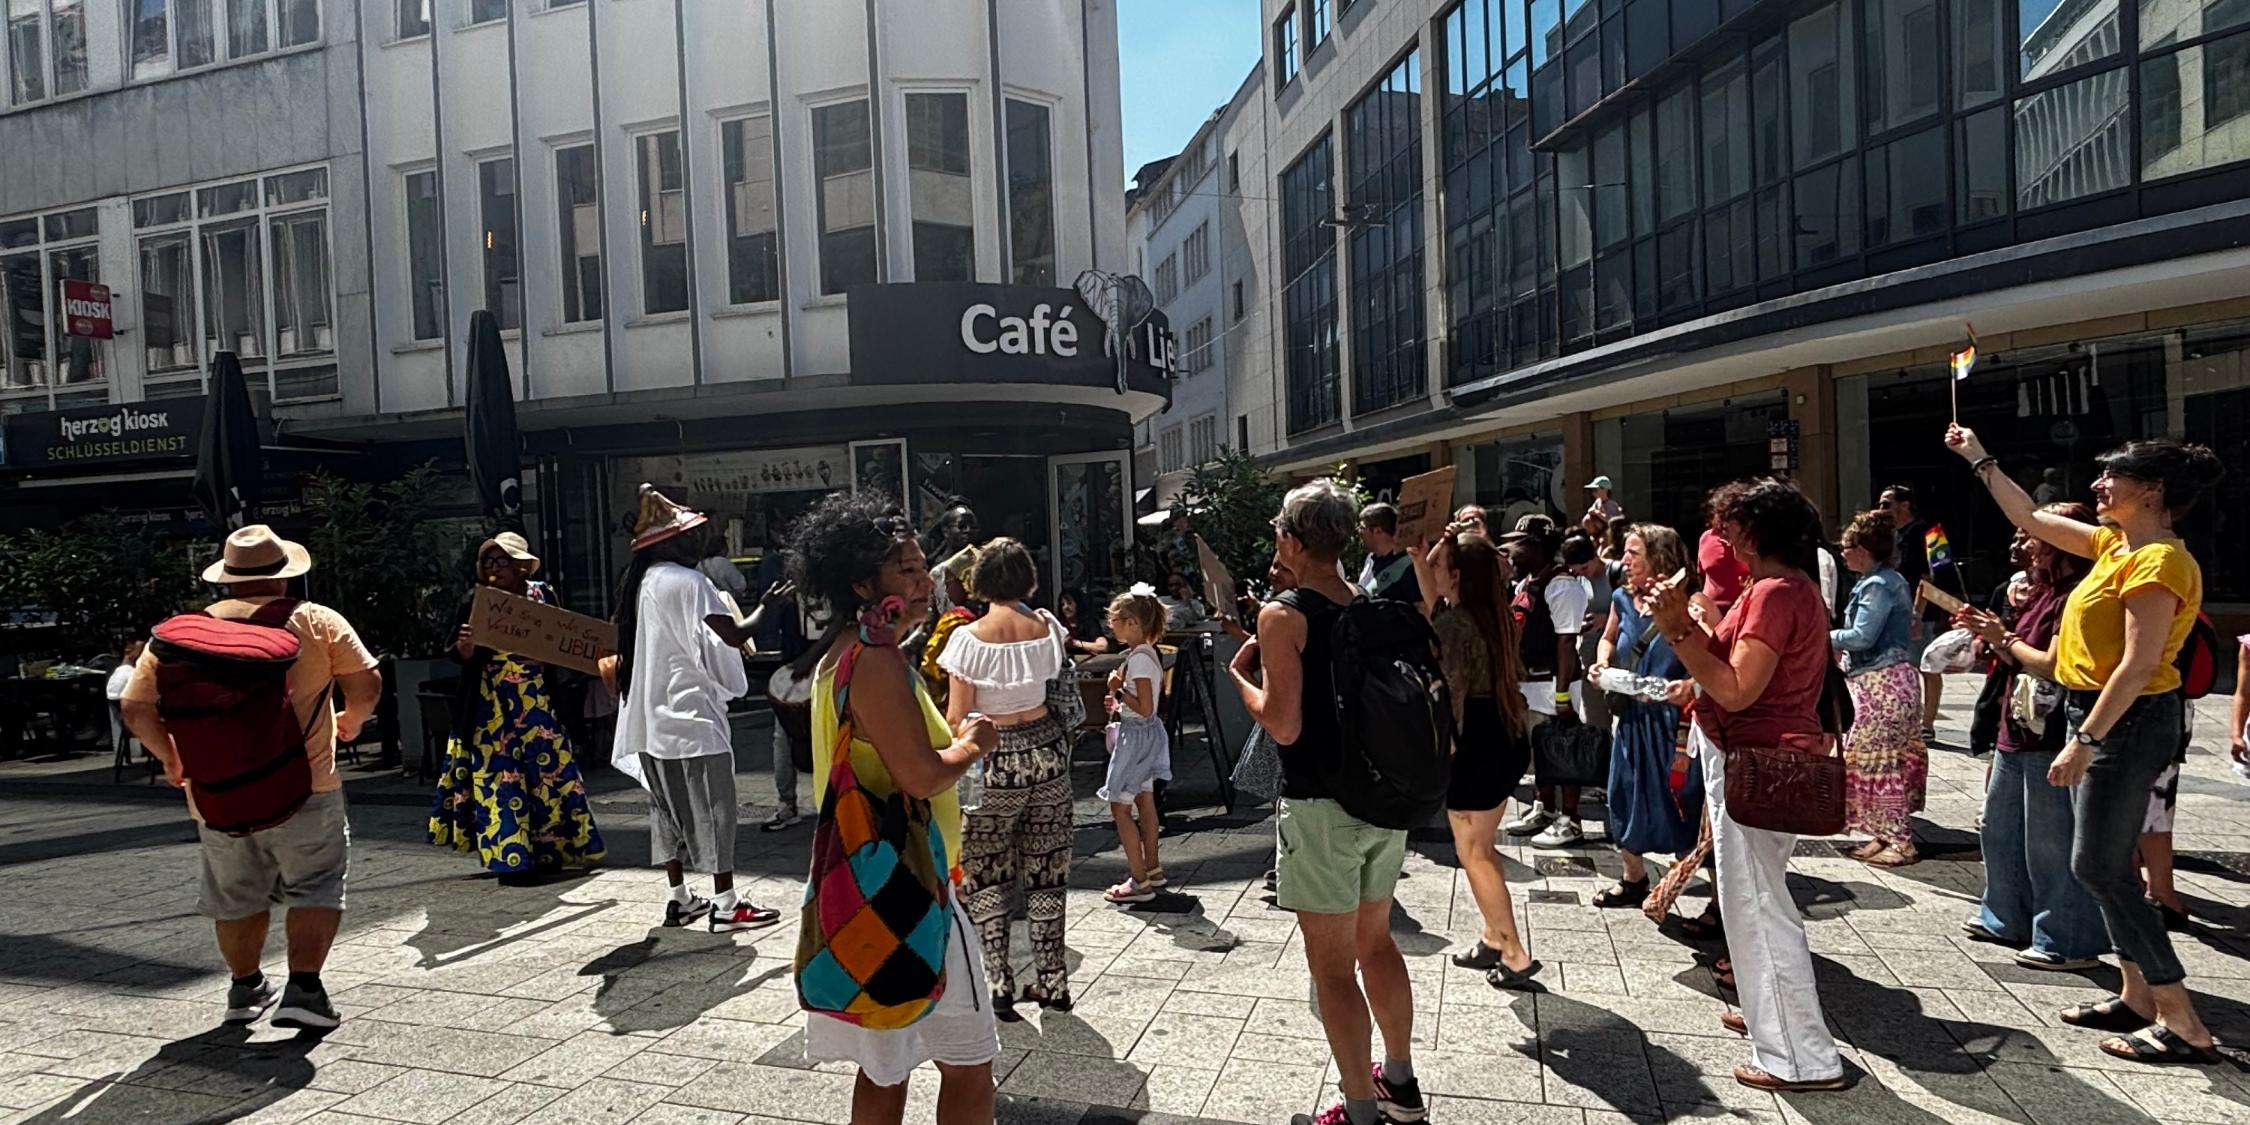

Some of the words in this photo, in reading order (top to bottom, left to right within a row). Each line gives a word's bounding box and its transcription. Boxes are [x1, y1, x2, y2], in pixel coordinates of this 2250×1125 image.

[67, 298, 111, 319] KIOSK
[961, 303, 1079, 357] Café
[61, 417, 121, 442] herzog
[47, 436, 187, 460] SCHLÜSSELDIENST
